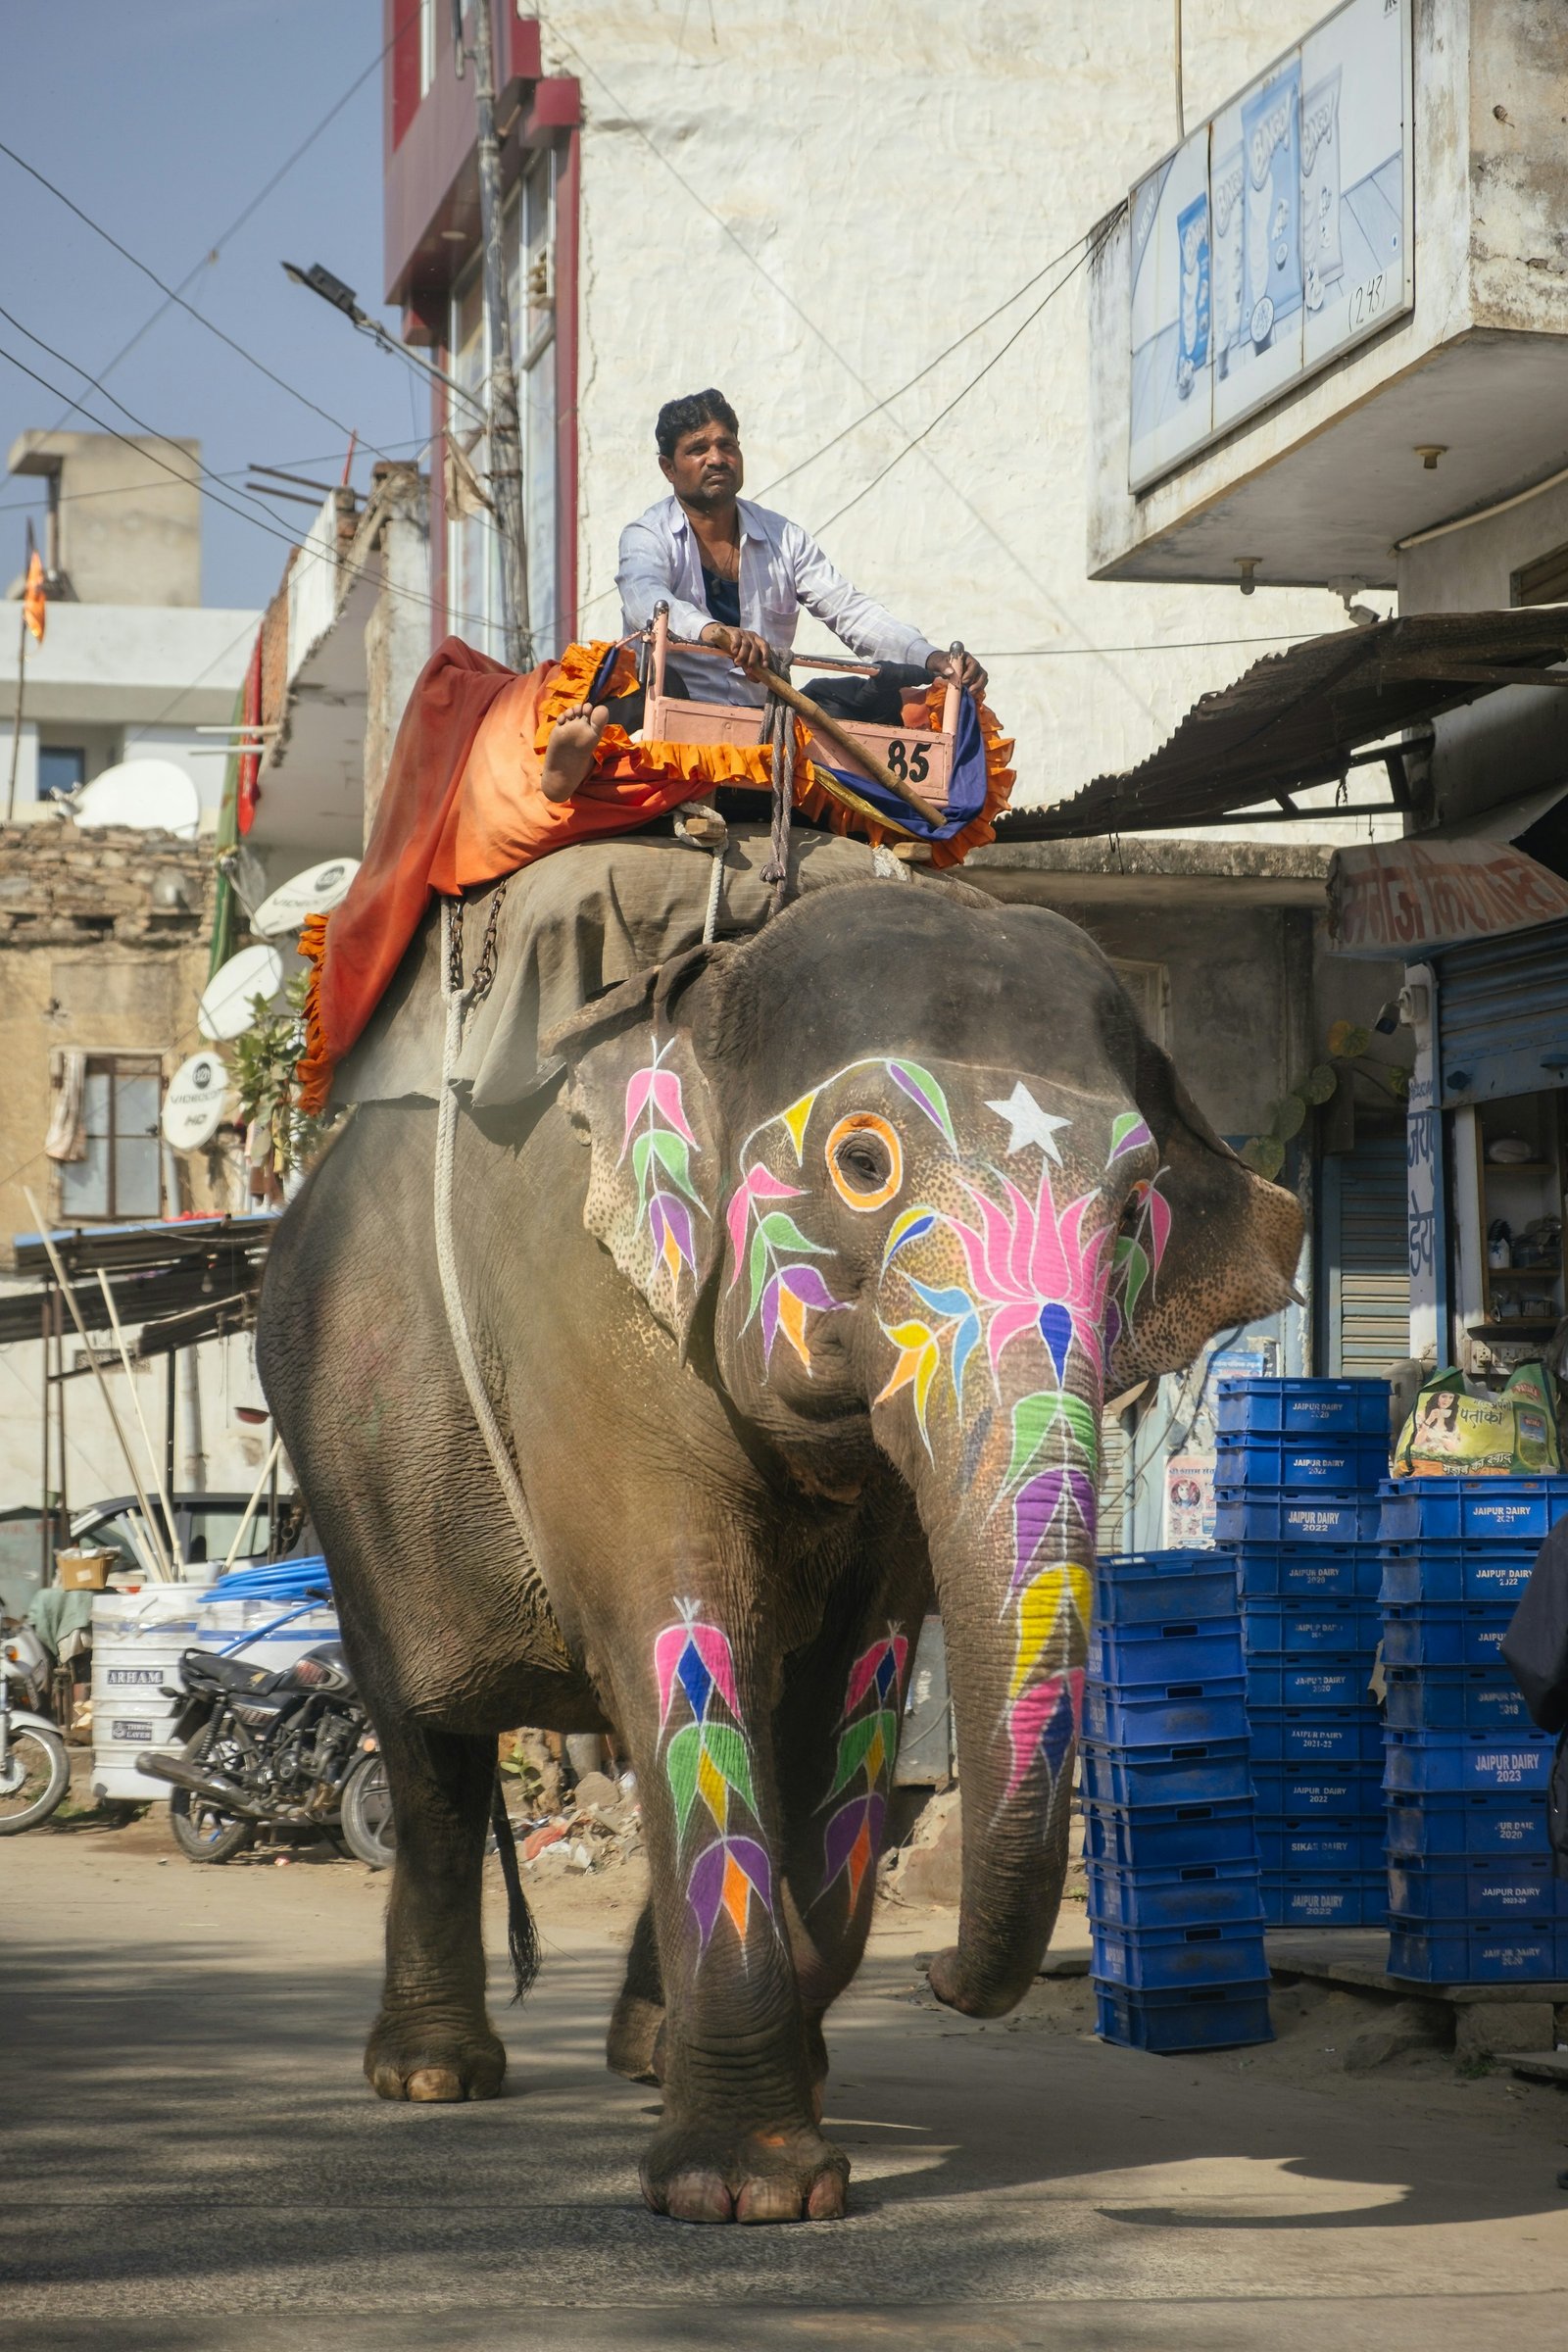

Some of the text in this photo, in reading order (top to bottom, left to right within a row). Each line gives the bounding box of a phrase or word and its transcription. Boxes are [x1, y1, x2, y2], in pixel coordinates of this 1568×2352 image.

[1136, 186, 1156, 247] NEW
[887, 740, 932, 783] 85
[1292, 1402, 1320, 1411] JAIPUR
[1460, 1408, 1503, 1428] पताका
[1506, 1506, 1531, 1515] DAIRY
[1288, 1511, 1340, 1525] JAIPUR DAIRY
[1478, 1633, 1506, 1642] JAIPU
[109, 1671, 161, 1684] ARHAM
[1323, 1676, 1347, 1685] DAIRY
[1302, 1740, 1333, 1748] 2021-22
[1475, 1754, 1540, 1771] JAIPUR DAIRY
[1496, 1770, 1522, 1783] 2023
[1499, 1831, 1523, 1839] 2020
[1321, 1842, 1348, 1851] DAIRY
[1515, 1887, 1541, 1896] DAIRY
[1291, 1894, 1345, 1907] JAIPUR DAIRY
